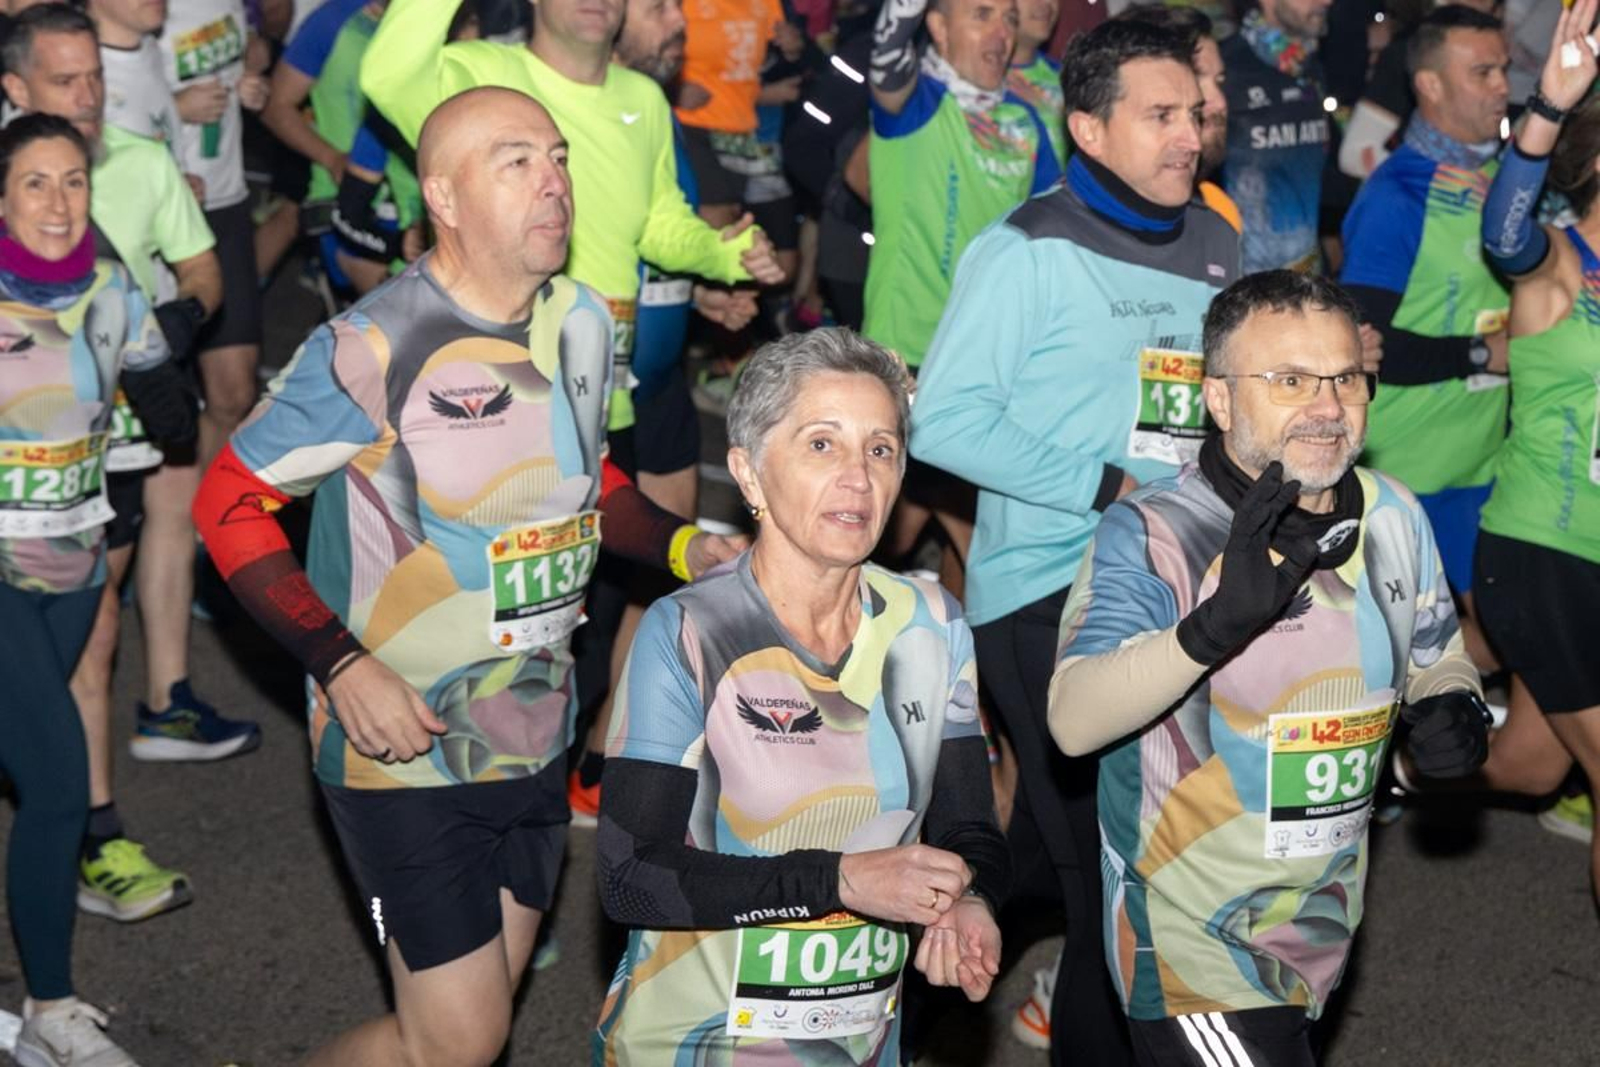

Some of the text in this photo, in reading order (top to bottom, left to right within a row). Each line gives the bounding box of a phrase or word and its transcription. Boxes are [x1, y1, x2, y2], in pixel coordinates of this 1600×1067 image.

[1250, 124, 1297, 149] SAN
[1161, 357, 1185, 376] 42
[441, 384, 501, 398] VALDEPEÑAS
[448, 419, 506, 431] ATHLETICS CLUB
[2, 456, 98, 500] 1287
[517, 528, 542, 552] 42
[505, 543, 592, 604] 1132
[747, 696, 811, 712] VALDEPEÑAS
[754, 733, 816, 745] ATHLETICS CLUB
[1312, 718, 1341, 744] 42
[733, 905, 811, 924] KIPRUN
[758, 926, 898, 984] 1049
[789, 987, 825, 997] ANTONIA
[827, 984, 858, 995] MORENO
